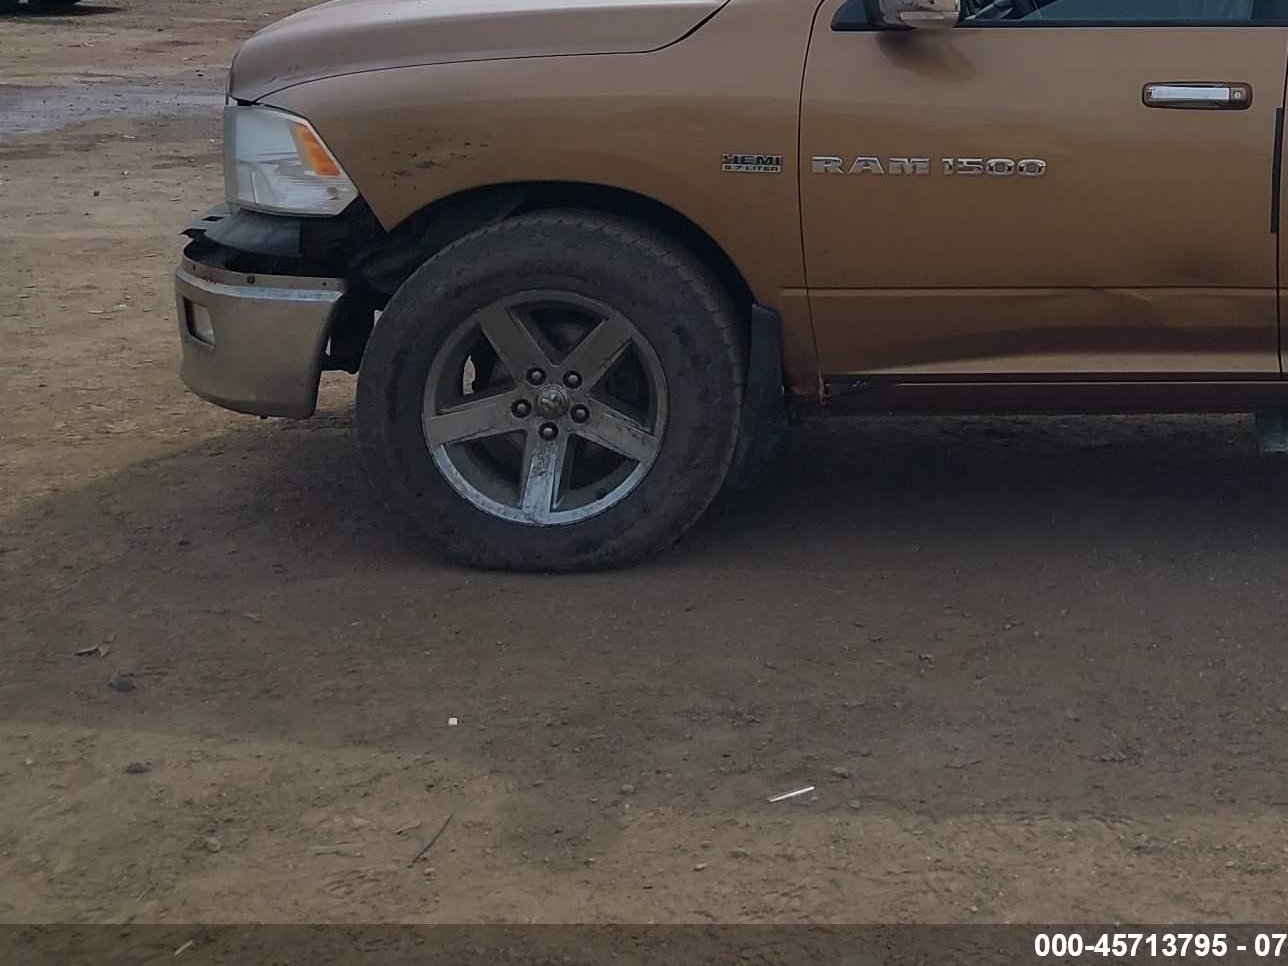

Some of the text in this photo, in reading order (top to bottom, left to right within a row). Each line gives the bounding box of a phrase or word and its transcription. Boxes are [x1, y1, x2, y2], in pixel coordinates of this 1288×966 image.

[722, 153, 782, 165] HEMI
[811, 156, 1047, 176] RAM 1500
